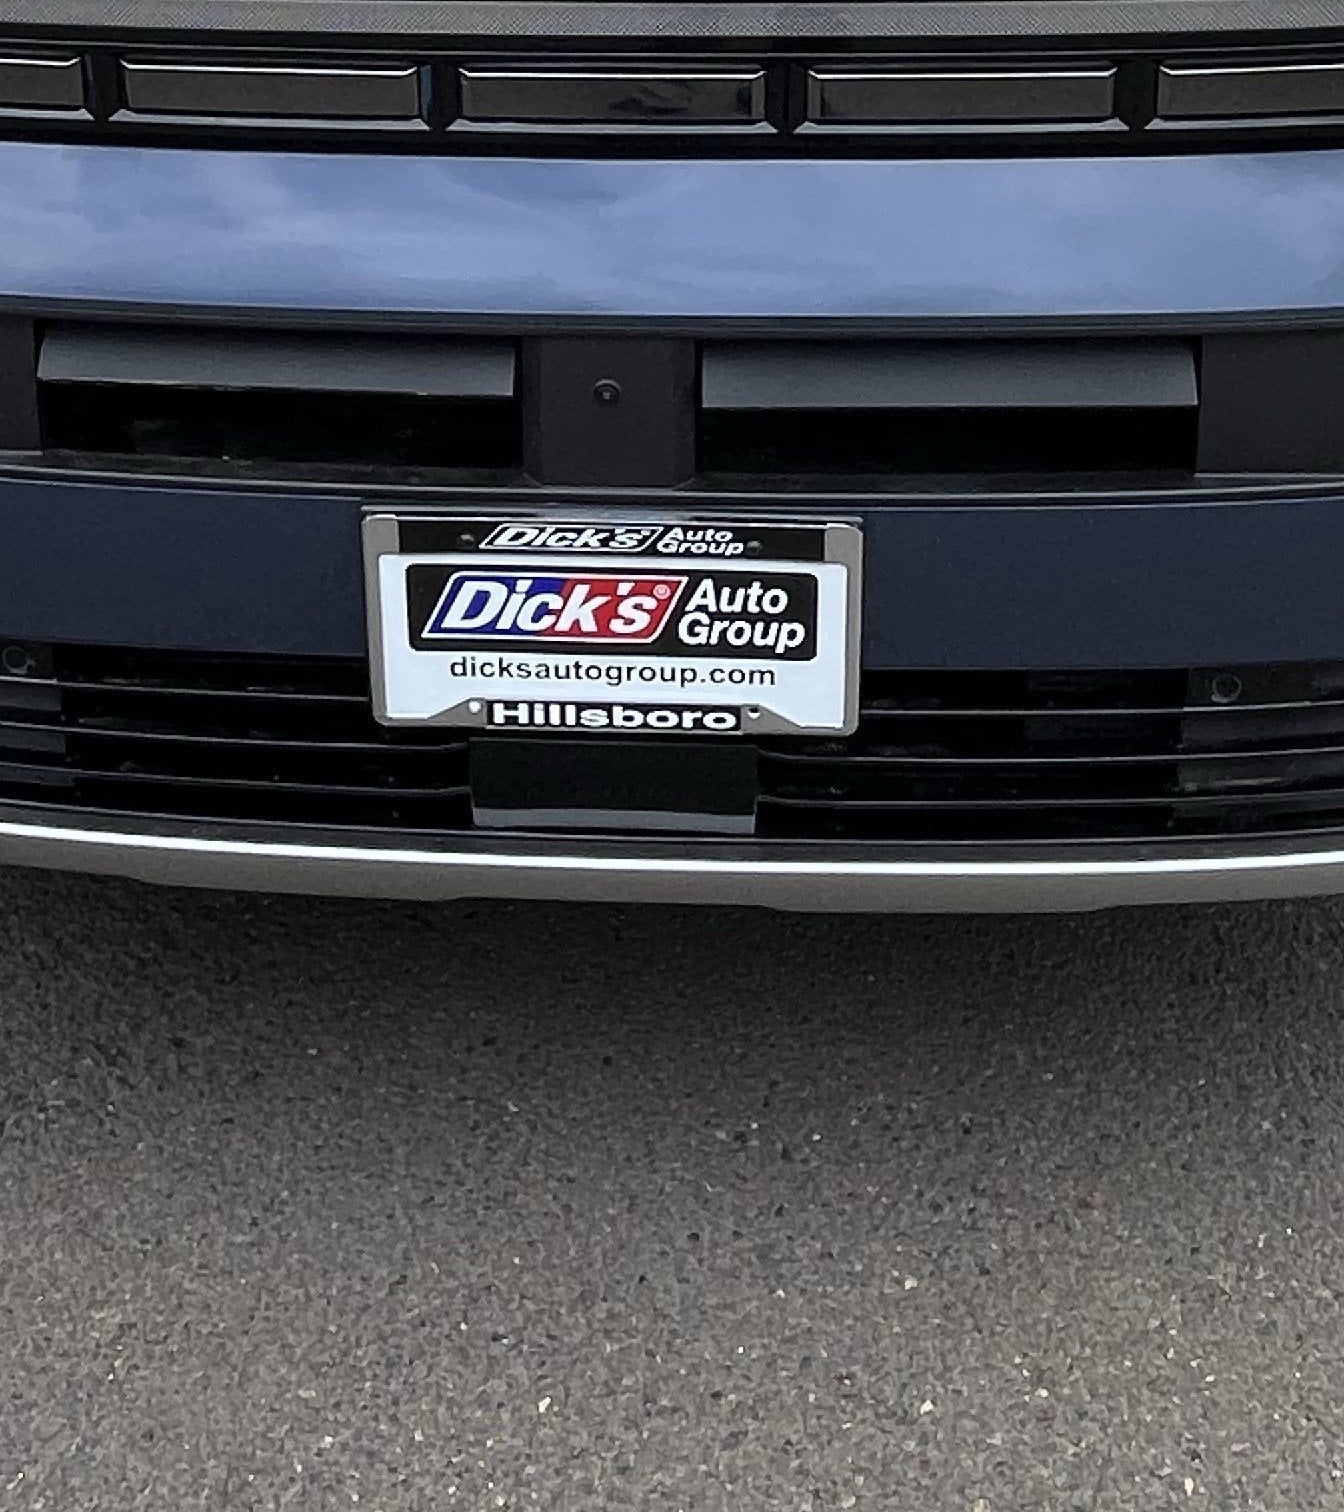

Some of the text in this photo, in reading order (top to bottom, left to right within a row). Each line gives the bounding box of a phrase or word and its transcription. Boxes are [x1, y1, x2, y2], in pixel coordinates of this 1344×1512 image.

[492, 526, 734, 549] Dick's Auto
[657, 539, 744, 556] Group
[439, 578, 789, 636] Dick's Auto
[677, 612, 806, 654] Group
[449, 656, 777, 688] dicksautogroup.com
[491, 702, 737, 731] Hillsboro
